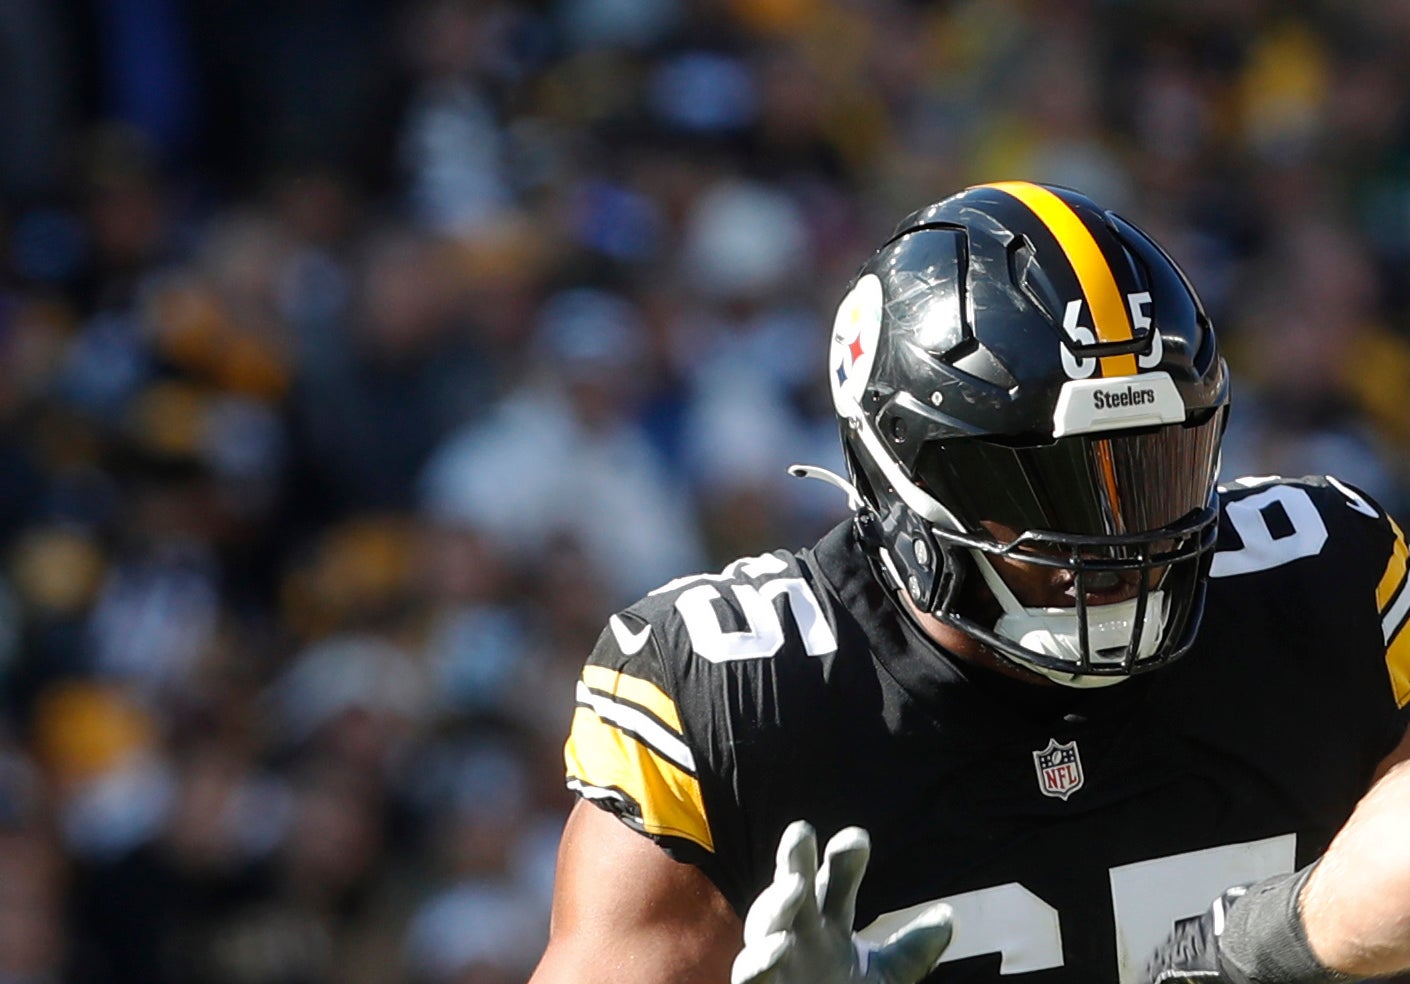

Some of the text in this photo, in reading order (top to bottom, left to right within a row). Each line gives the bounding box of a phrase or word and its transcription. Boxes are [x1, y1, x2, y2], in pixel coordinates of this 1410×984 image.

[1060, 292, 1163, 380] 65
[1093, 385, 1155, 410] Steelers
[1045, 765, 1077, 790] NFL
